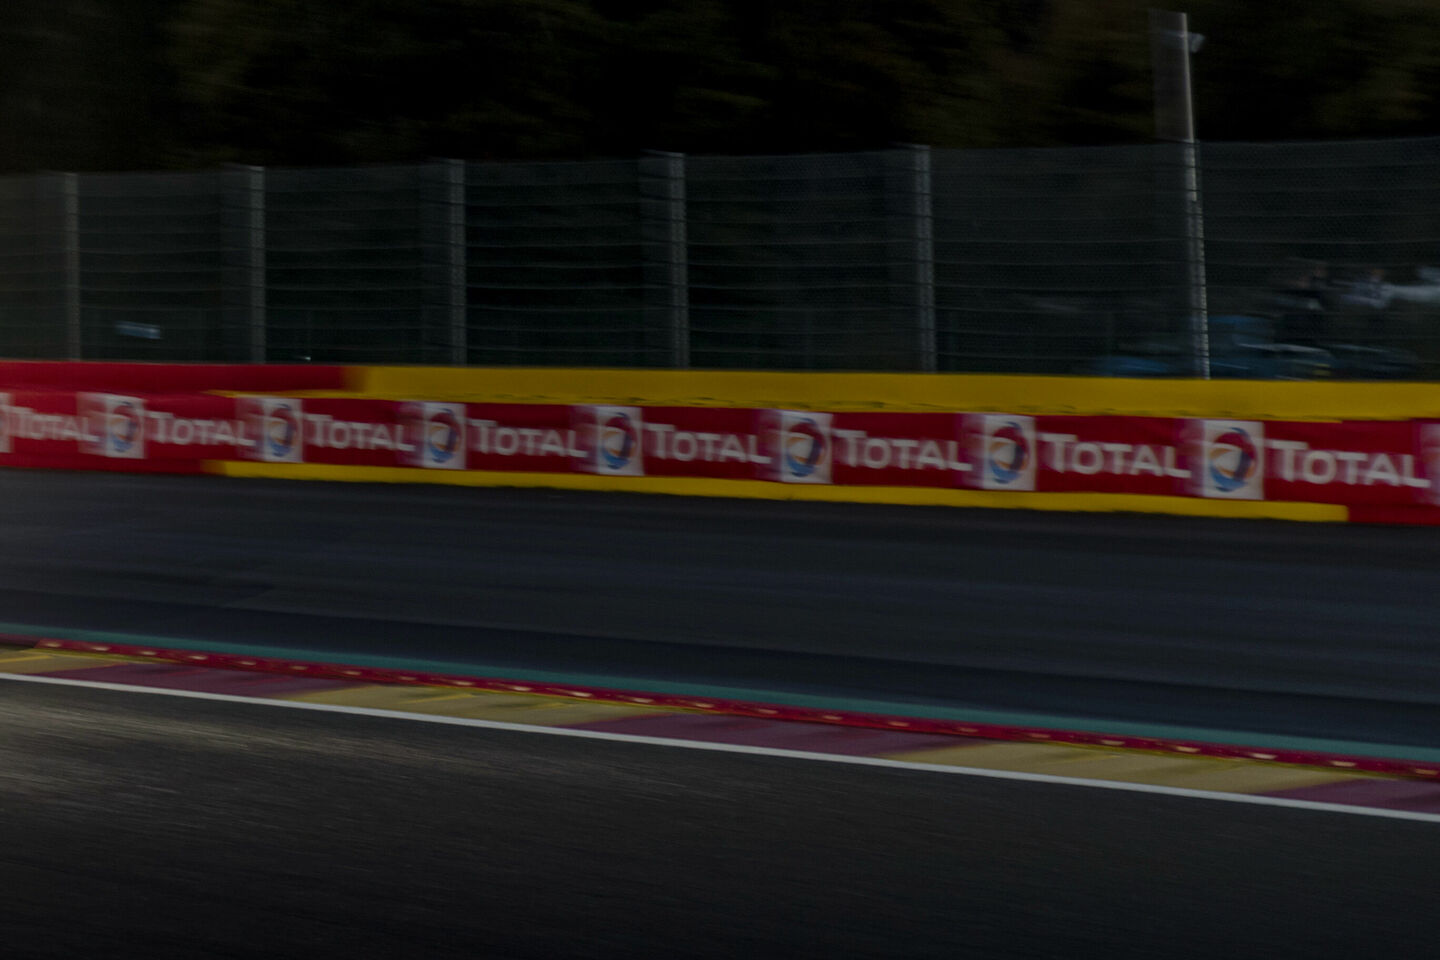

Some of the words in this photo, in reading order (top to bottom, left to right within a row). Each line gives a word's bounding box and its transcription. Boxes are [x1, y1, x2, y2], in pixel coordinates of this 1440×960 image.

[143, 409, 256, 446] TOTAL
[304, 413, 420, 452] TOTAL
[468, 418, 588, 458] TOTAL
[645, 422, 770, 464] TOTAL
[832, 428, 972, 471] TOTAL
[1038, 432, 1190, 478] TOTAL
[1270, 439, 1430, 488] TOTAL
